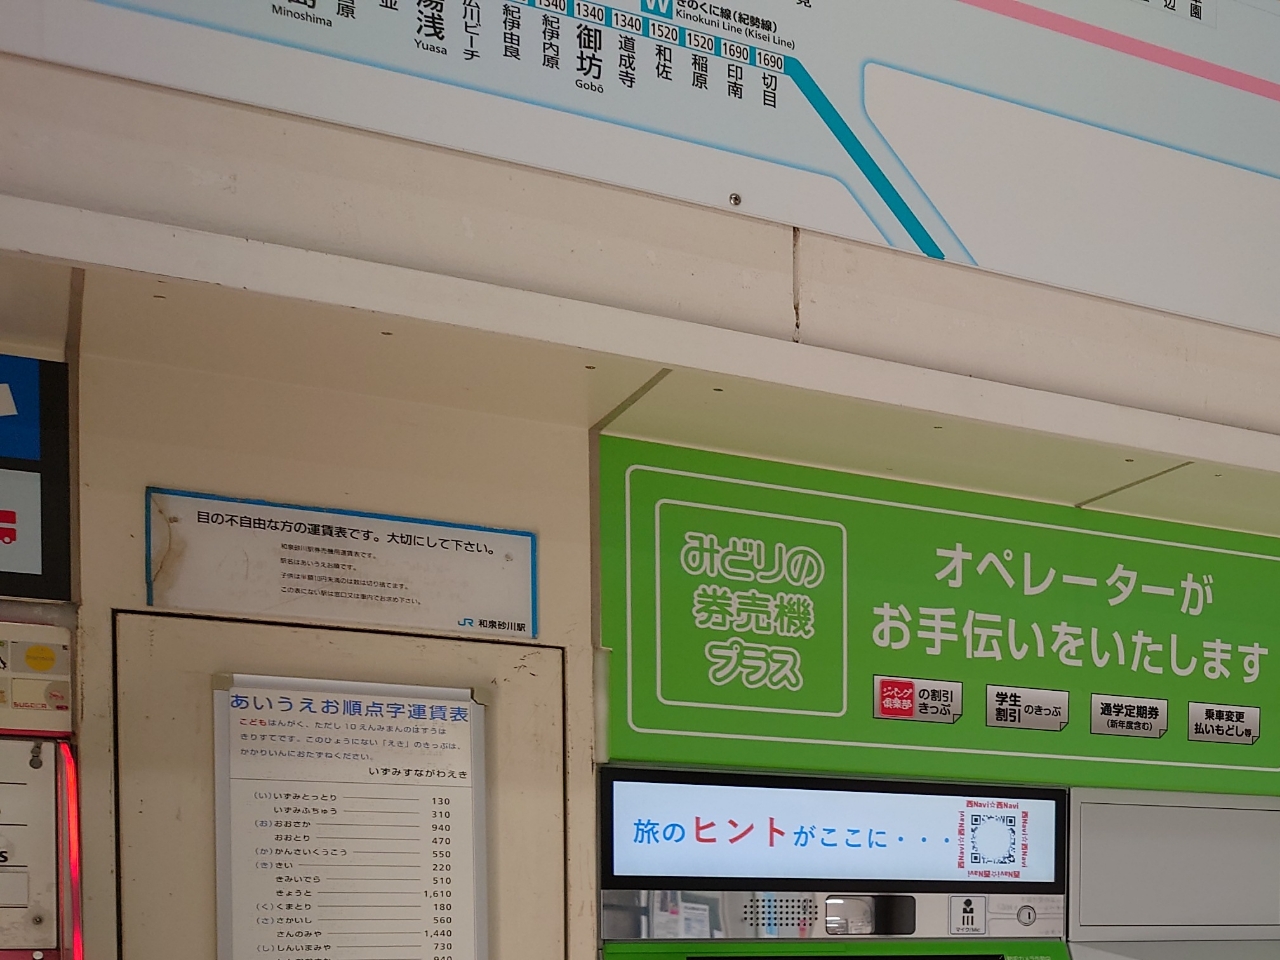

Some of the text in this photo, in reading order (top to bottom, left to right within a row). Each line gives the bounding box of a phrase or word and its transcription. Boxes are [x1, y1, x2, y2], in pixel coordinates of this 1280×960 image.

[272, 4, 332, 27] Minoshima
[577, 3, 604, 21] 1340
[676, 9, 743, 33] Kinokuni Line
[614, 13, 641, 31] 1340
[503, 4, 521, 60] 紀伊由良
[651, 23, 678, 42] 1520
[414, 38, 447, 55] Yuasa
[542, 14, 561, 70] 紀伊内原
[687, 32, 714, 51] 1520
[576, 23, 603, 79] 御坊
[723, 42, 748, 60] 1690
[619, 35, 636, 88] 道成寺
[655, 44, 672, 80] 和佐
[758, 51, 783, 70] 1690
[692, 54, 708, 90] 稲原
[727, 64, 743, 99] 印南
[762, 73, 777, 108] 切目
[680, 531, 825, 588] みどりの
[935, 542, 1214, 616] オペレーターが
[692, 584, 814, 639] 券売機
[478, 619, 526, 632] 和泉砂川駅
[872, 602, 1269, 684] お手伝いをいたします
[705, 636, 803, 691] プラス
[882, 686, 912, 697] ジパング
[918, 688, 953, 703] の割引
[995, 691, 1021, 707] 学生
[230, 694, 469, 722] あいうえお順点字運賃表
[918, 702, 951, 716] きっぷ
[995, 707, 1021, 723] 割引
[1024, 704, 1061, 718] のきっぷ
[1100, 702, 1159, 720] 通学定期券
[1205, 708, 1244, 723] 乗車変更
[1107, 719, 1152, 731] （新年度含む）
[1194, 722, 1252, 737] 払いもどし等
[369, 767, 467, 779] いずみすながわえき
[274, 806, 337, 814] いずみふちゅう
[432, 797, 450, 805] 130
[432, 824, 450, 832] 940
[275, 834, 450, 845] おおとり 470
[276, 889, 451, 898] きょうと 1,610
